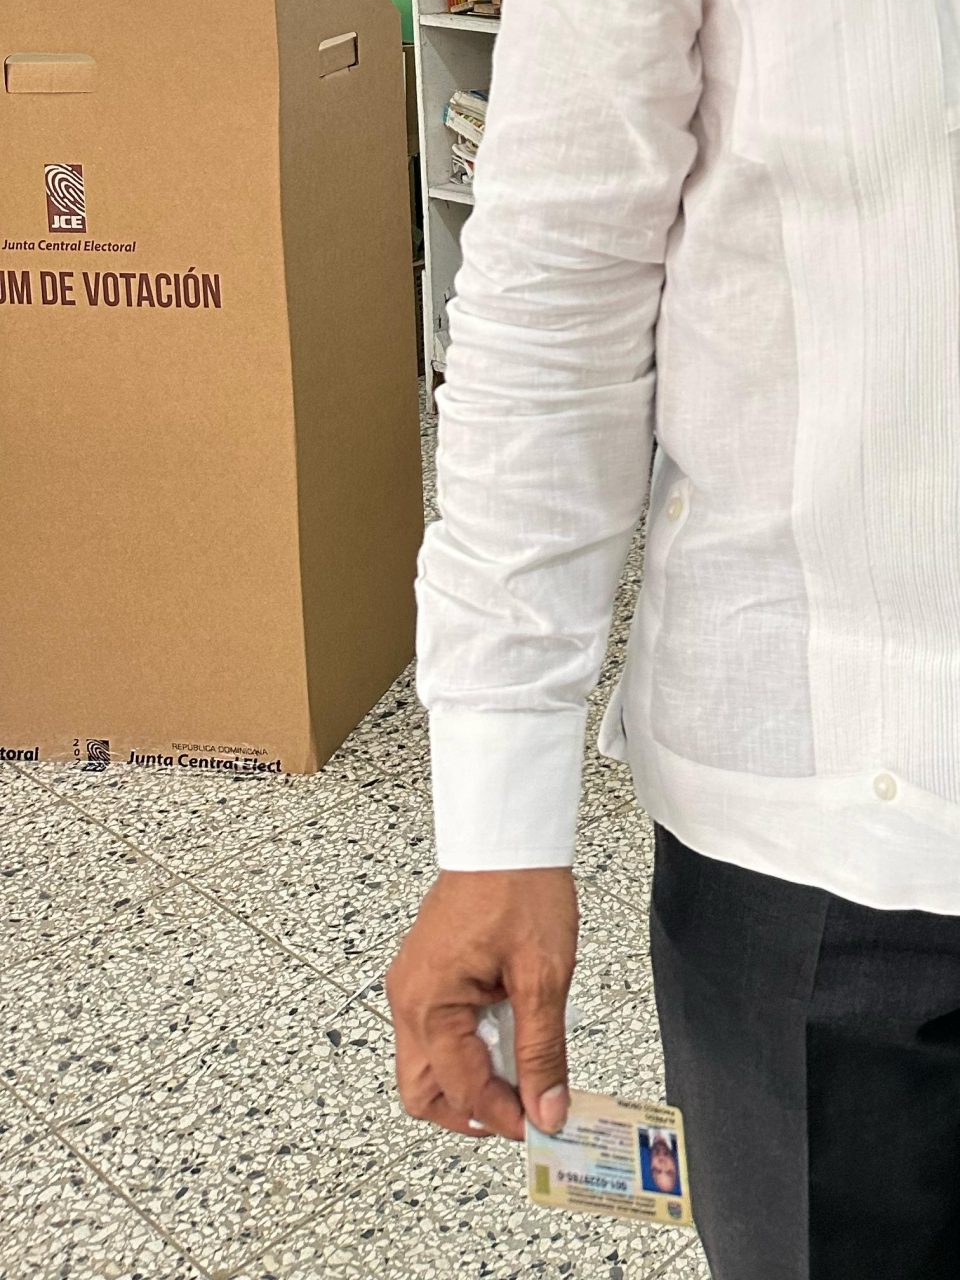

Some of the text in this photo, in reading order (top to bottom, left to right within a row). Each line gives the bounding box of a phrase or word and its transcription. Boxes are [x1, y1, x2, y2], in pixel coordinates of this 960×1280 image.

[51, 215, 83, 229] JCE
[2, 239, 137, 252] Junta Central Electoral
[40, 271, 76, 306] DE
[82, 266, 222, 308] VOTACIÓN
[126, 751, 174, 768] Junta
[178, 754, 239, 771] Central
